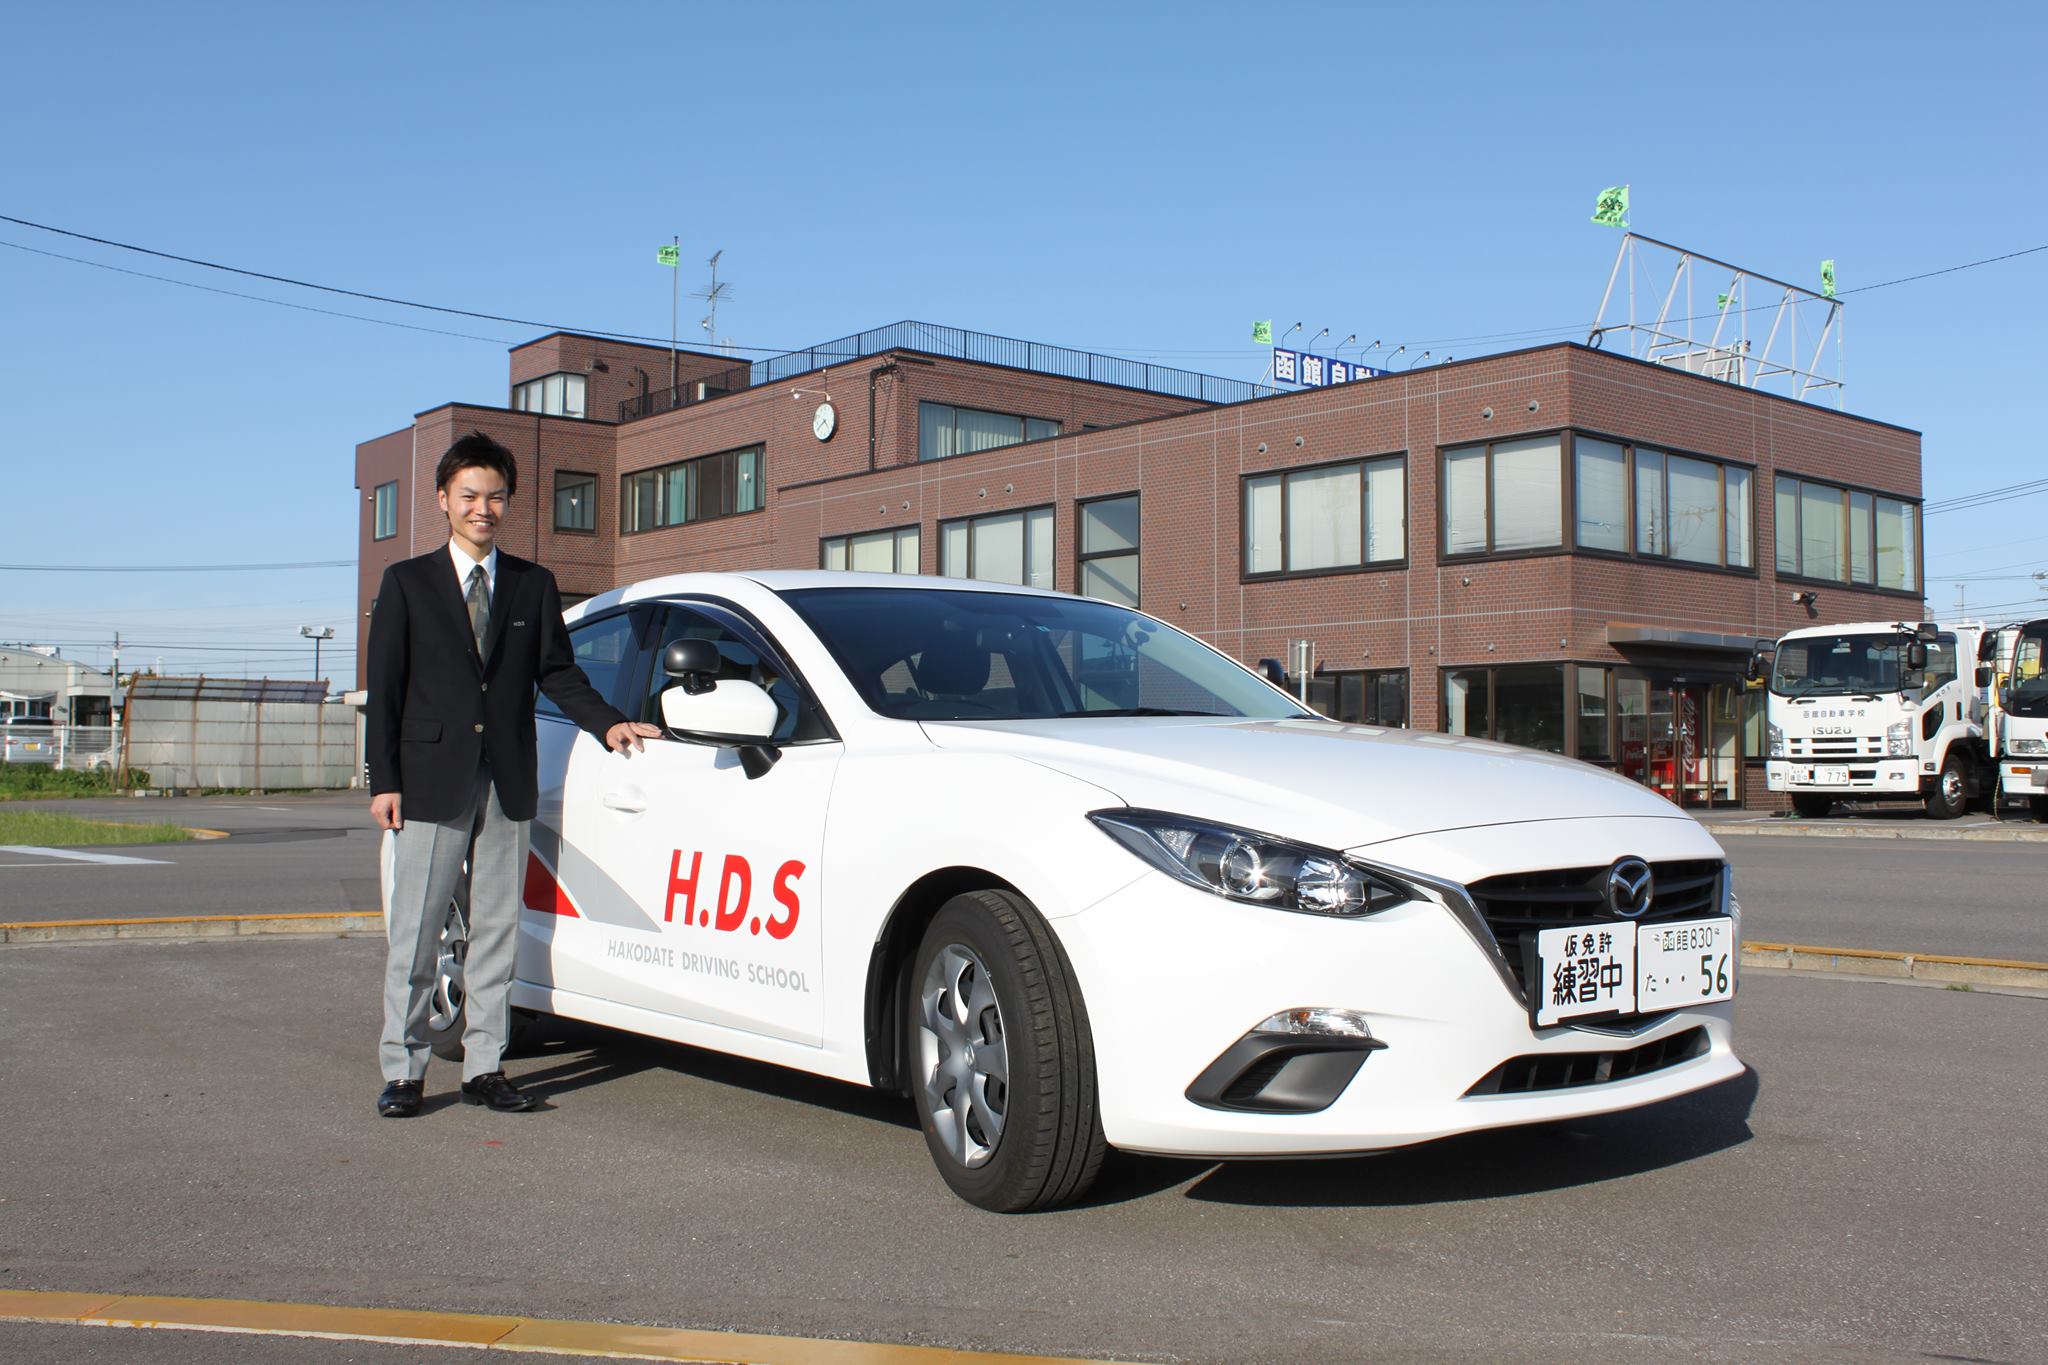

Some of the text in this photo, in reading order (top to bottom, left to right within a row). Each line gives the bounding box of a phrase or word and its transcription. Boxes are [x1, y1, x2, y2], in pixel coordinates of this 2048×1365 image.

[664, 849, 806, 940] H.D.S
[607, 939, 810, 993] HAKODATE DRIVING SCHOOL
[1564, 931, 1613, 958] 仮免許
[1552, 955, 1623, 1006] 練習中
